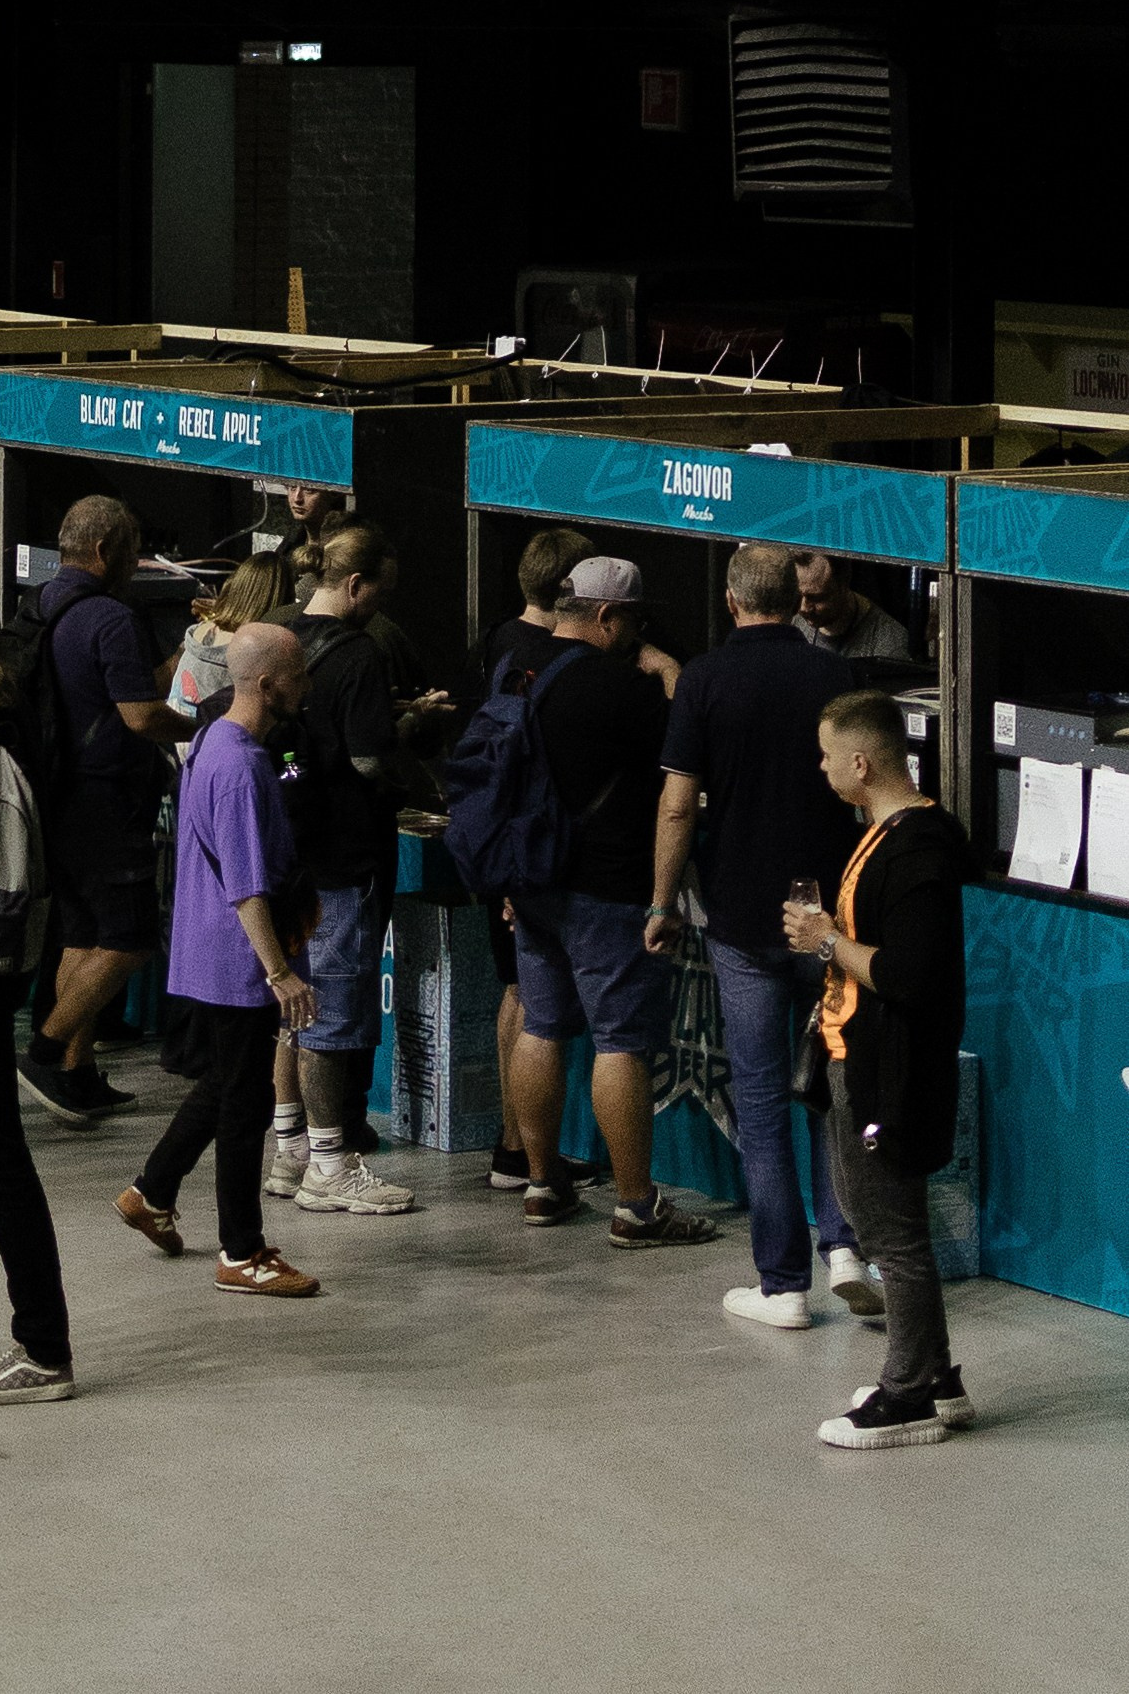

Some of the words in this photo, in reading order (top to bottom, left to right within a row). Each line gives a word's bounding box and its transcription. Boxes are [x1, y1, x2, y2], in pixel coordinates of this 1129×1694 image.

[1096, 353, 1120, 368] GIN
[80, 393, 116, 427] BLACK
[122, 398, 144, 431] CAT
[178, 405, 216, 441] REBEL
[222, 410, 261, 446] APPLE
[662, 459, 733, 502] ZAGOVOR
[681, 502, 715, 522] Москва
